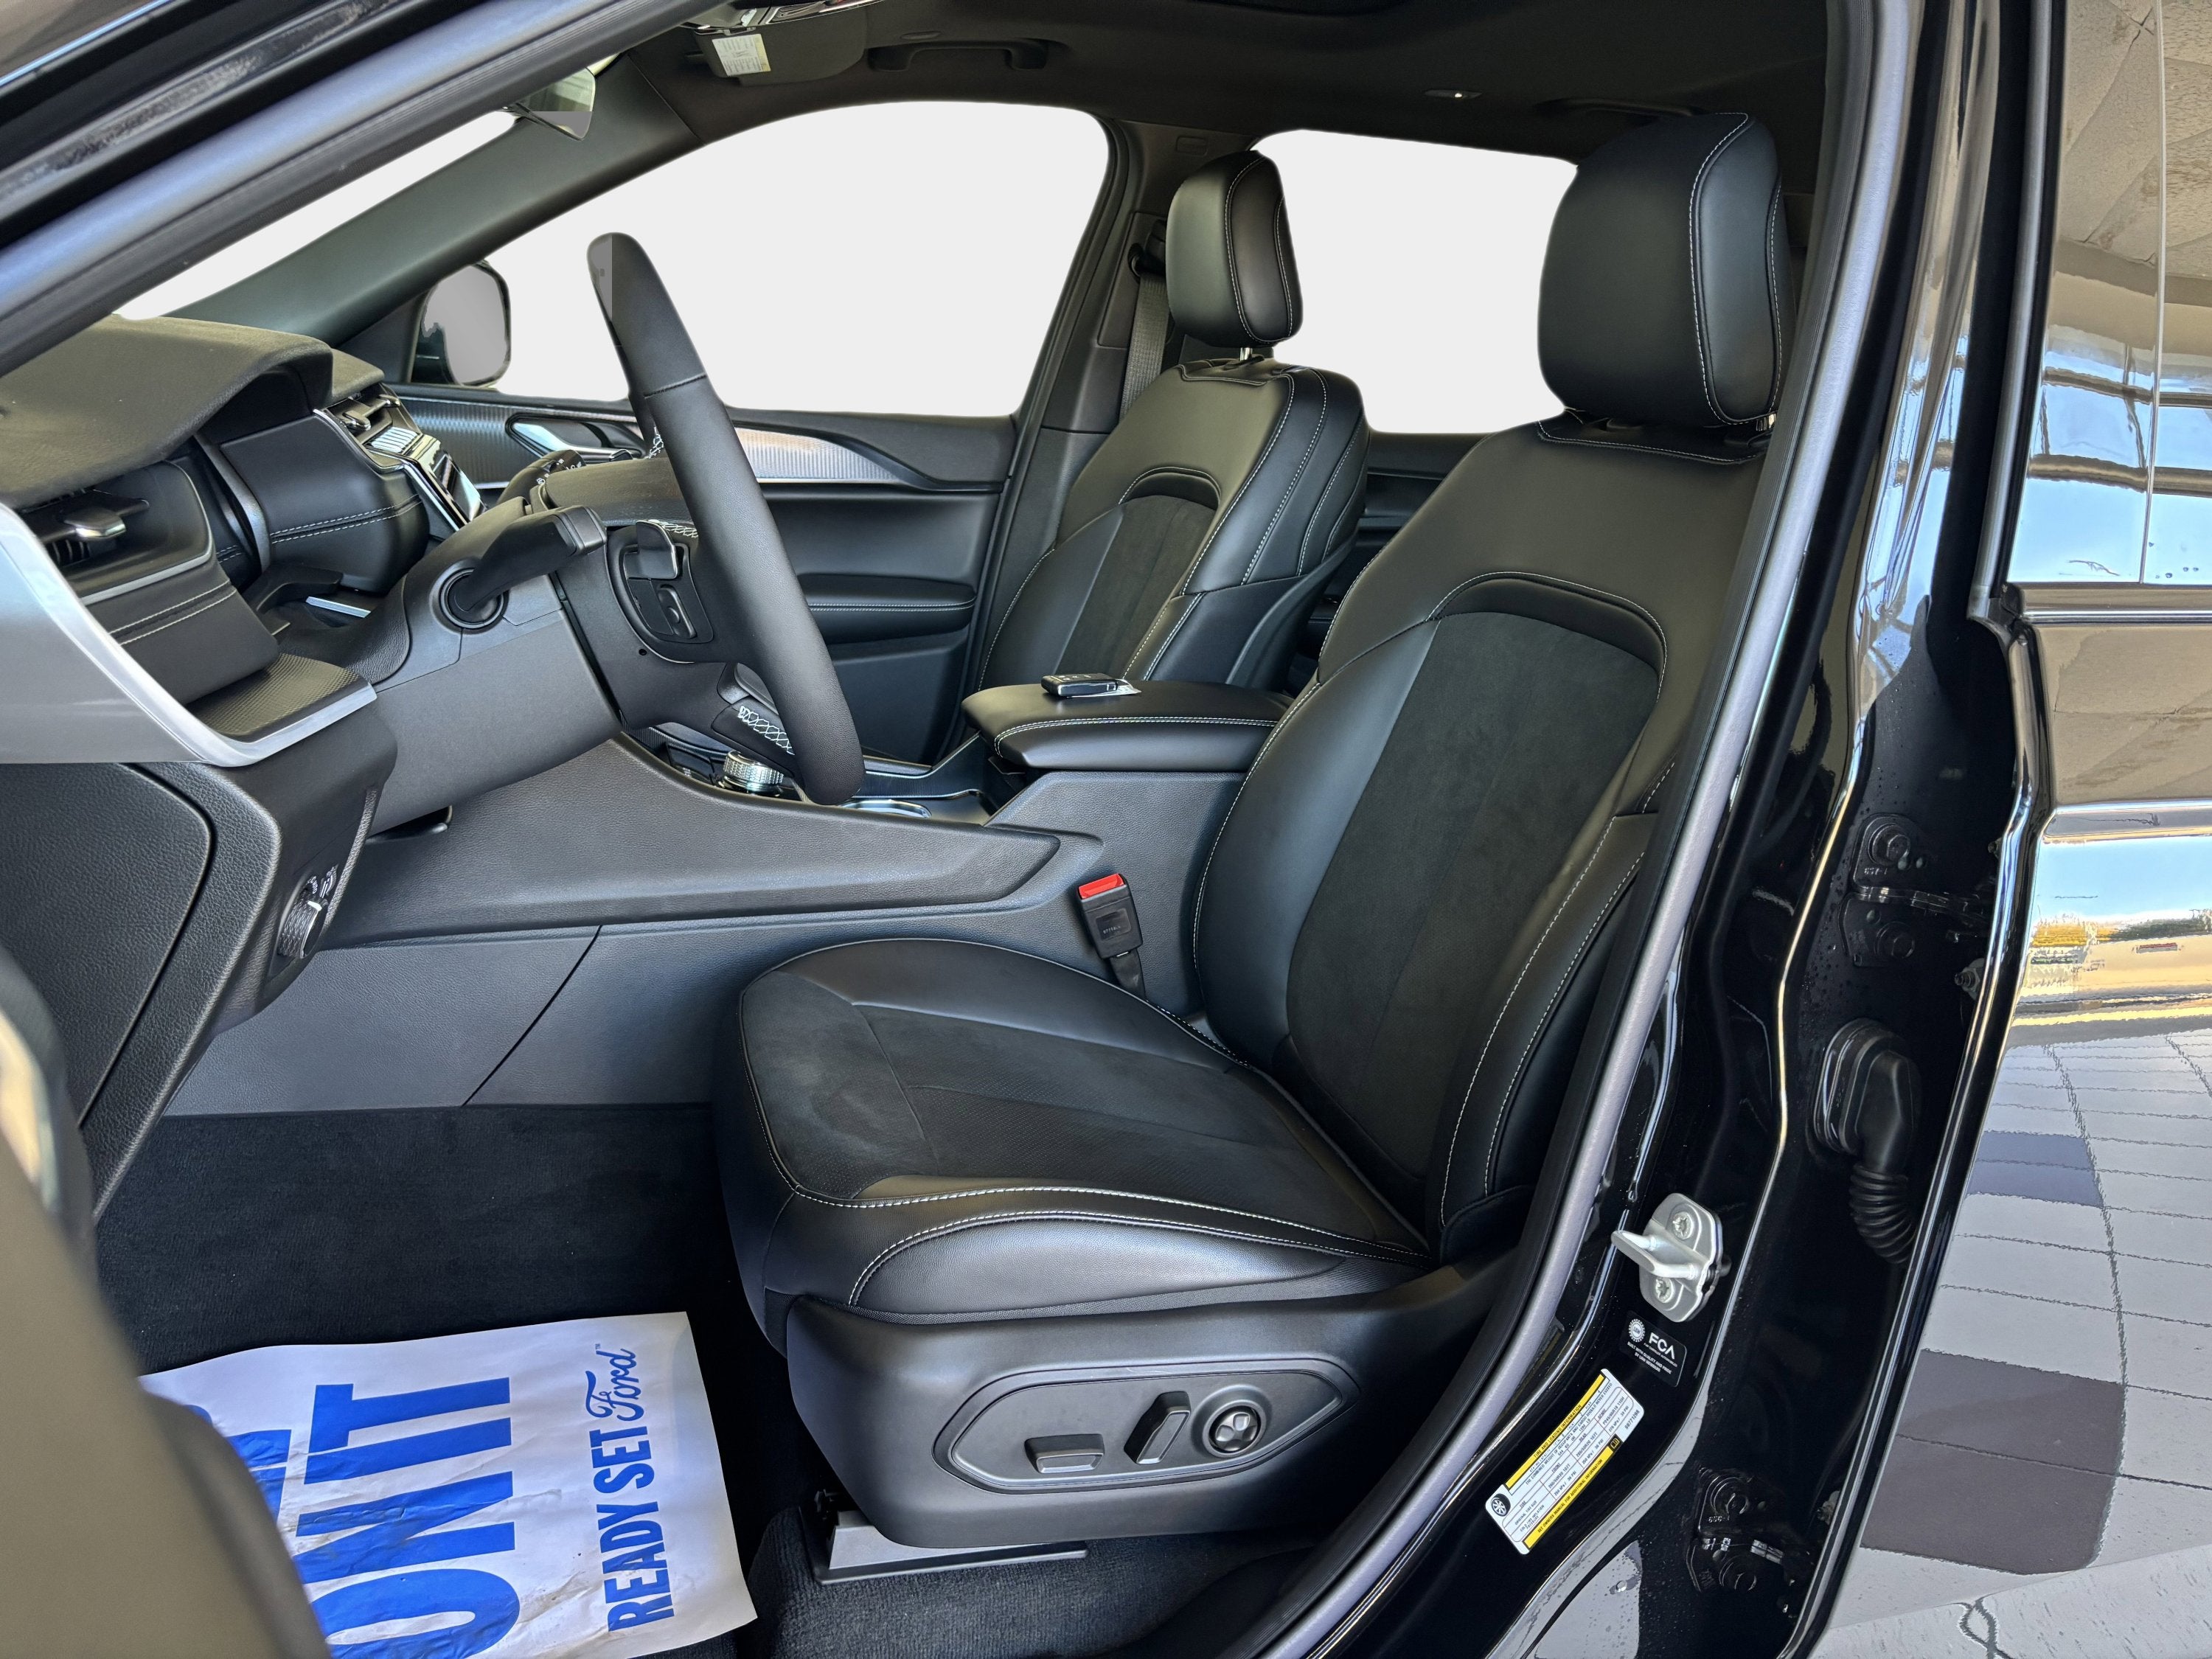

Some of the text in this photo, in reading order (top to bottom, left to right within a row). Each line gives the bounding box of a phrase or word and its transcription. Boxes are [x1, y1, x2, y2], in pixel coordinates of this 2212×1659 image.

[1649, 1332, 1675, 1360] FCA
[585, 1348, 645, 1422] Ford
[589, 1425, 655, 1494] SET
[597, 1500, 675, 1632] READY
